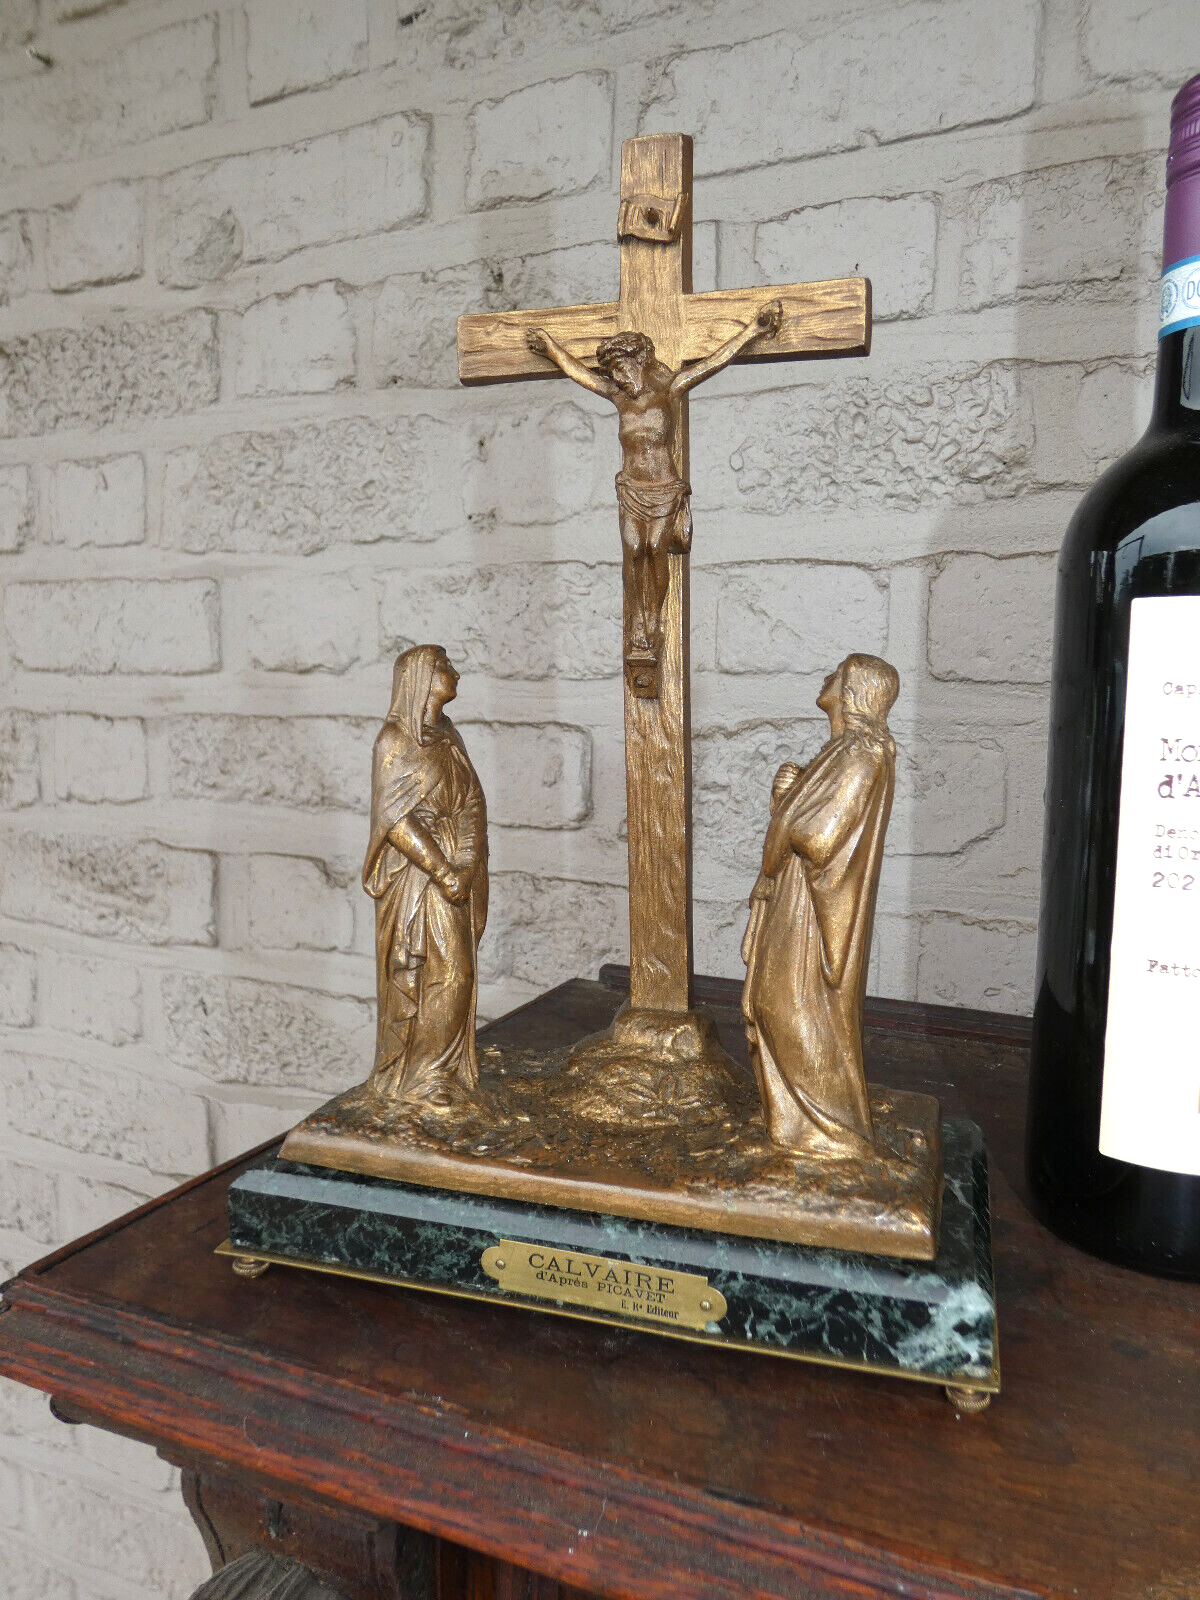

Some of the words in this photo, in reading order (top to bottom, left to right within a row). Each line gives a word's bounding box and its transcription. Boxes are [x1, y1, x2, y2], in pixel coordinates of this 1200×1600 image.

[1163, 682, 1200, 699] Cap
[1160, 738, 1200, 763] Mo
[1151, 871, 1195, 890] 202
[528, 1253, 675, 1294] CALVAIRE
[597, 1282, 666, 1303] PICAVET
